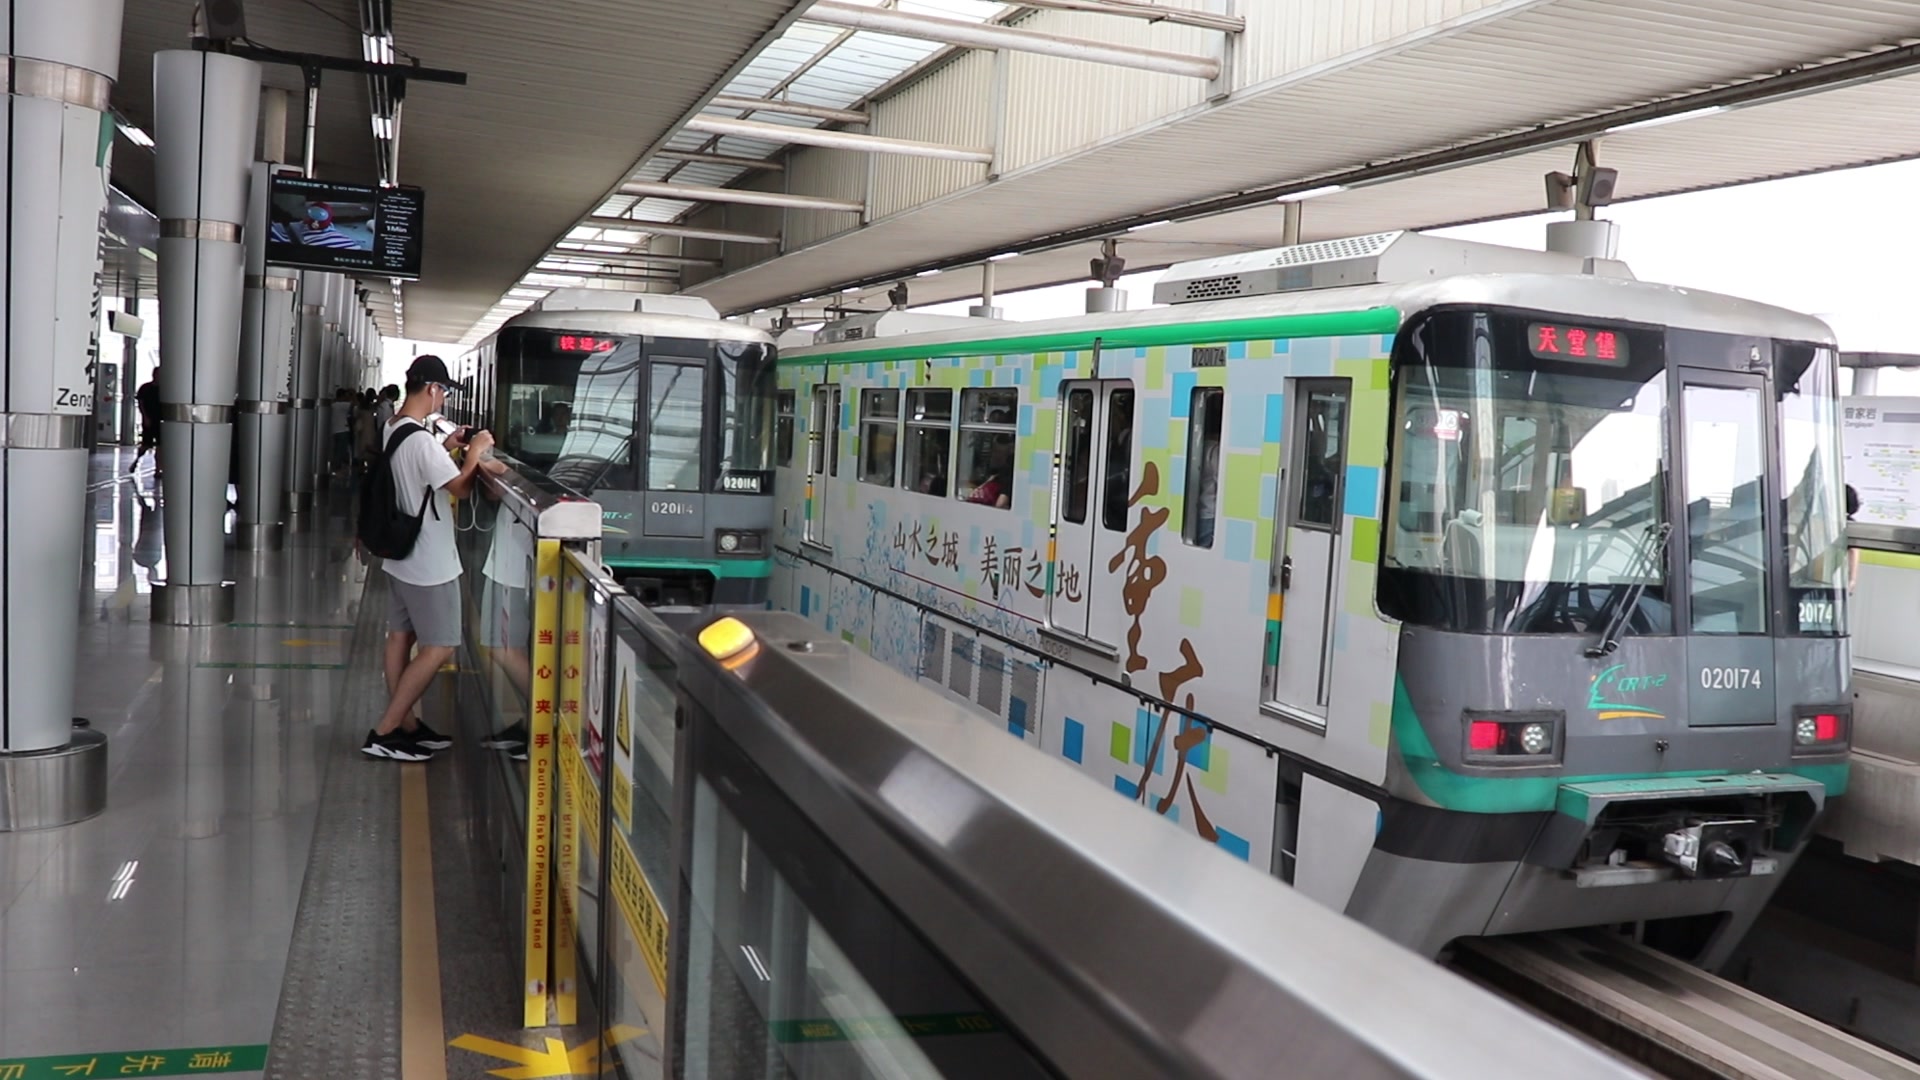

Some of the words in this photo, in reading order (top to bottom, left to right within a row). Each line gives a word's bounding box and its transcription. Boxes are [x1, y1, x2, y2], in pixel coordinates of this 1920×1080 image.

[1537, 326, 1617, 359] 天堂堡
[1845, 407, 1877, 420] 曾家岩
[723, 476, 757, 490] 020114
[894, 519, 959, 572] 山水之城
[980, 535, 1083, 603] 美丽之地
[534, 629, 553, 749] 当心夹手
[1701, 667, 1762, 690] 020174
[535, 814, 546, 841] Risk
[535, 844, 546, 859] Of
[532, 862, 546, 916] Pinching
[533, 918, 543, 949] Hand
